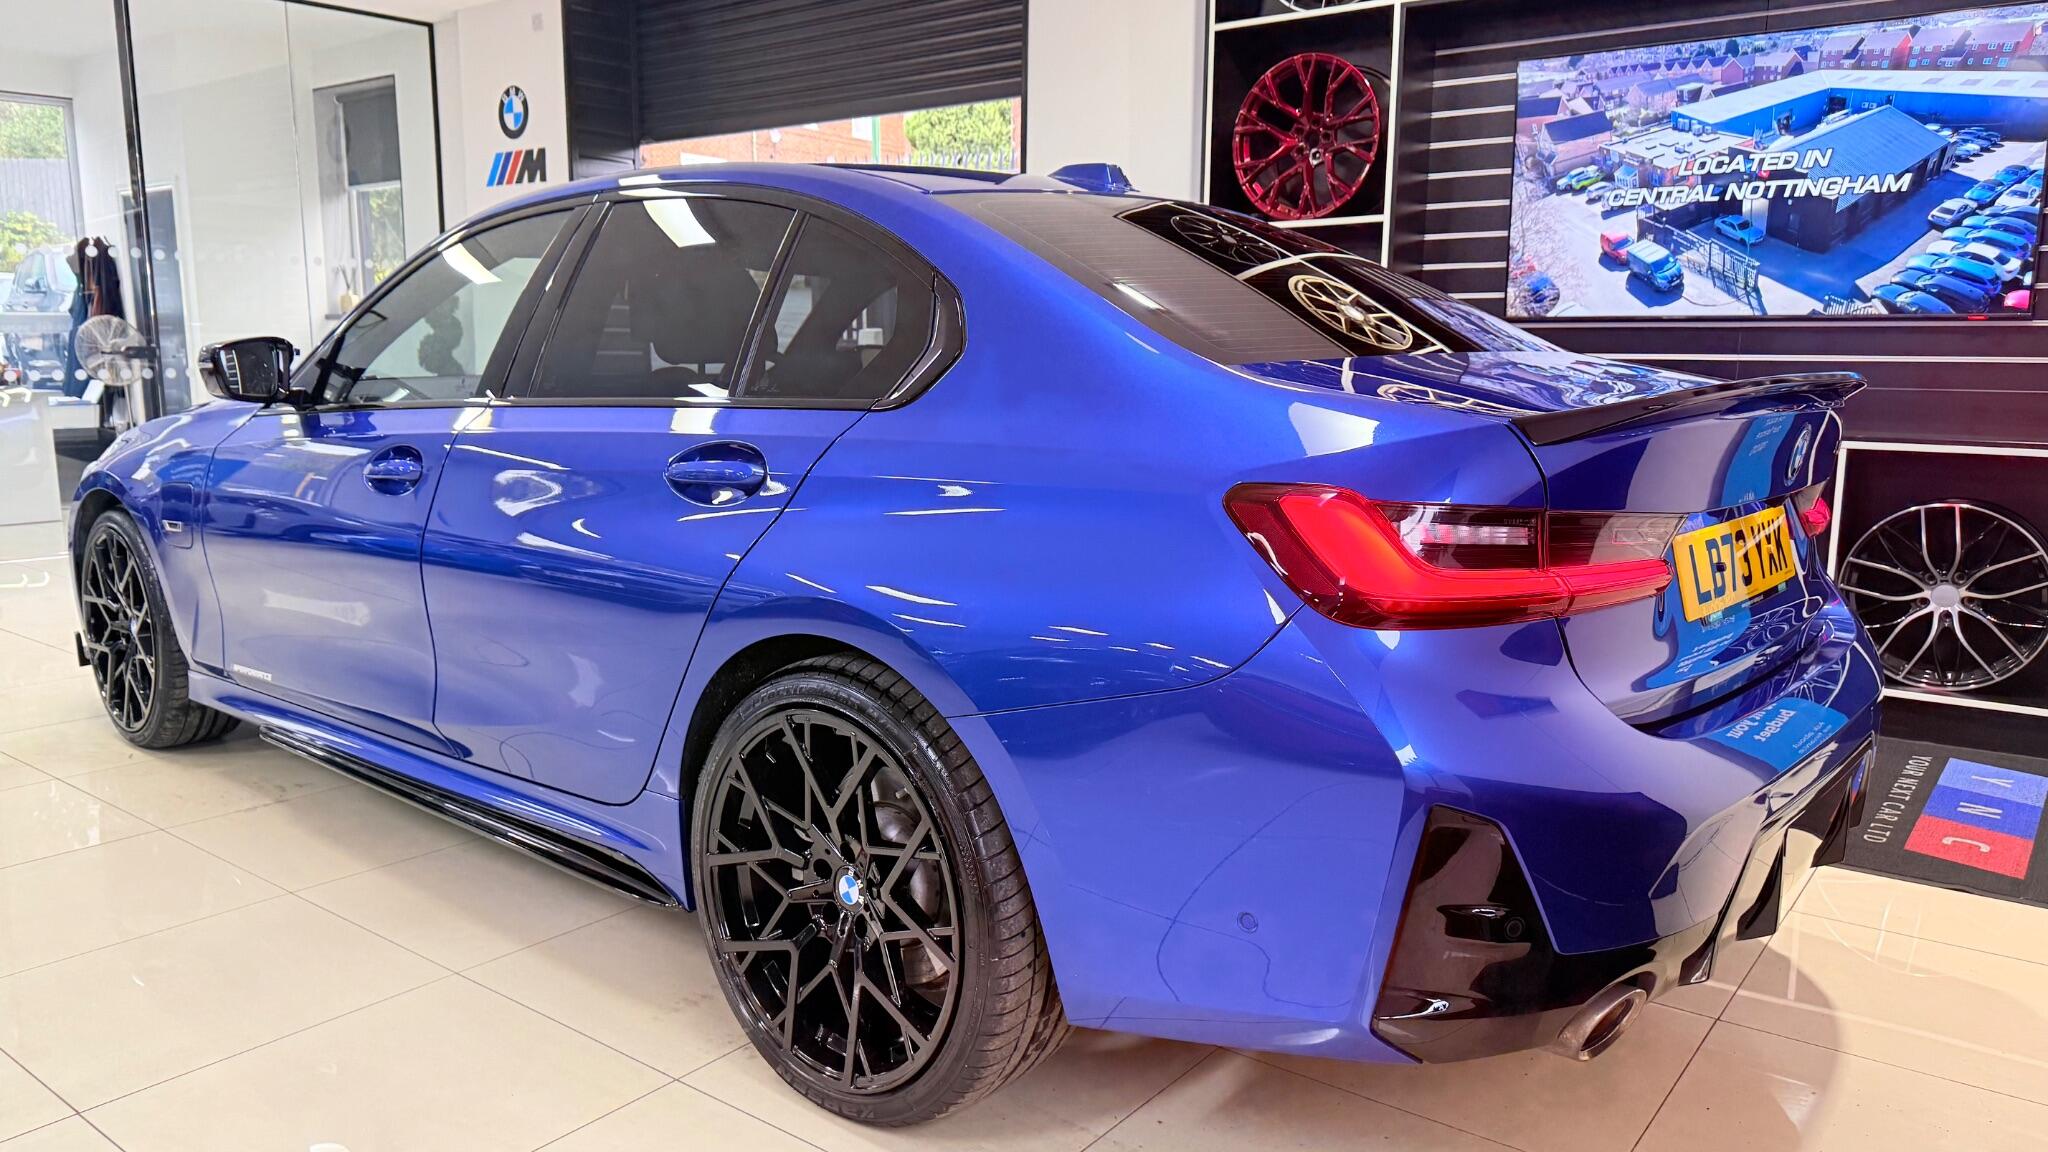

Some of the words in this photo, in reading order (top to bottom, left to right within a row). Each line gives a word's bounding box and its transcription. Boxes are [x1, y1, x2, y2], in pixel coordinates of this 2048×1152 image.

[1678, 150, 1800, 177] LOCATED
[1801, 148, 1832, 169] IN
[1607, 184, 1720, 207] CENTRAL
[1724, 172, 1912, 201] NOTTINGHAM
[1688, 529, 1753, 606] LB73
[1901, 755, 1933, 777] YOUR
[1888, 777, 1919, 801] NEXT
[1874, 801, 1905, 821] CAR
[1863, 823, 1893, 843] LTD
